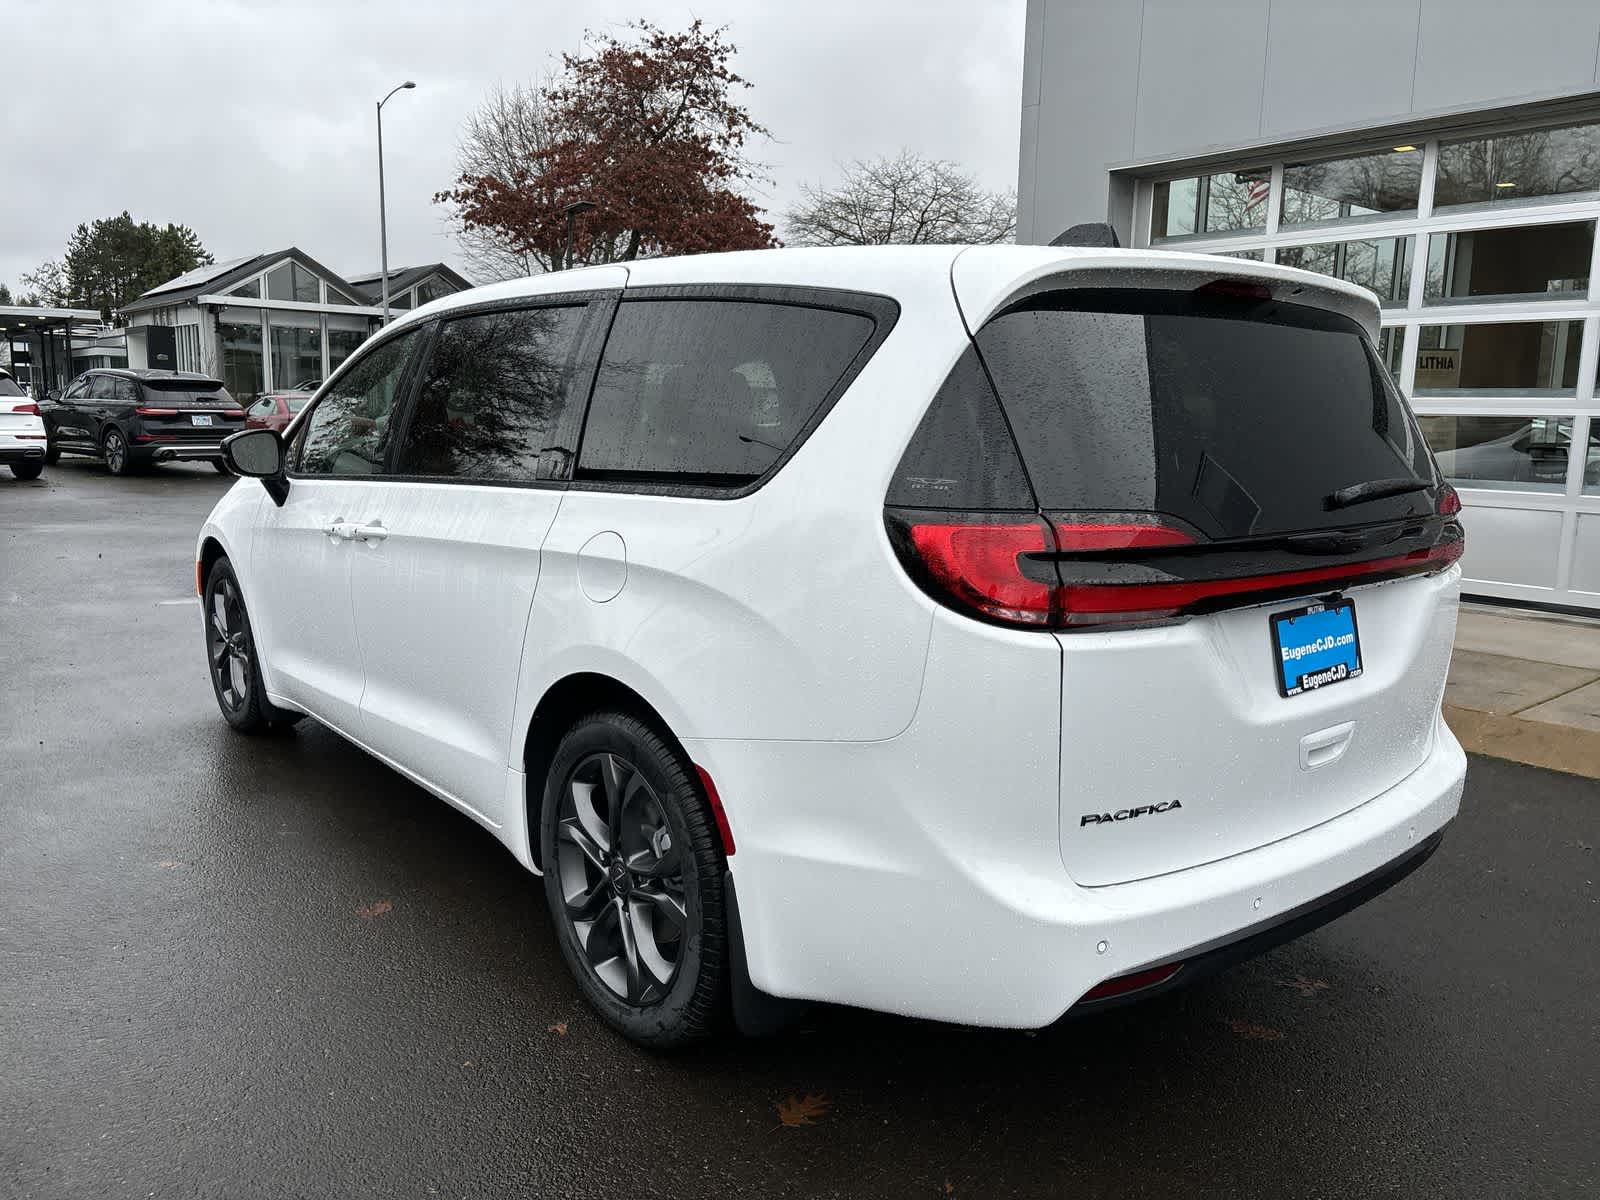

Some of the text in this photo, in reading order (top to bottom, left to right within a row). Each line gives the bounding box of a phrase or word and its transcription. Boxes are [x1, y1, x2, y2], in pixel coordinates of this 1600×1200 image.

[1420, 356, 1454, 369] LITHIA
[1281, 633, 1354, 661] EugeneCJD.com
[1302, 664, 1346, 689] EugeneCJD
[1080, 799, 1182, 827] PACIFICA
